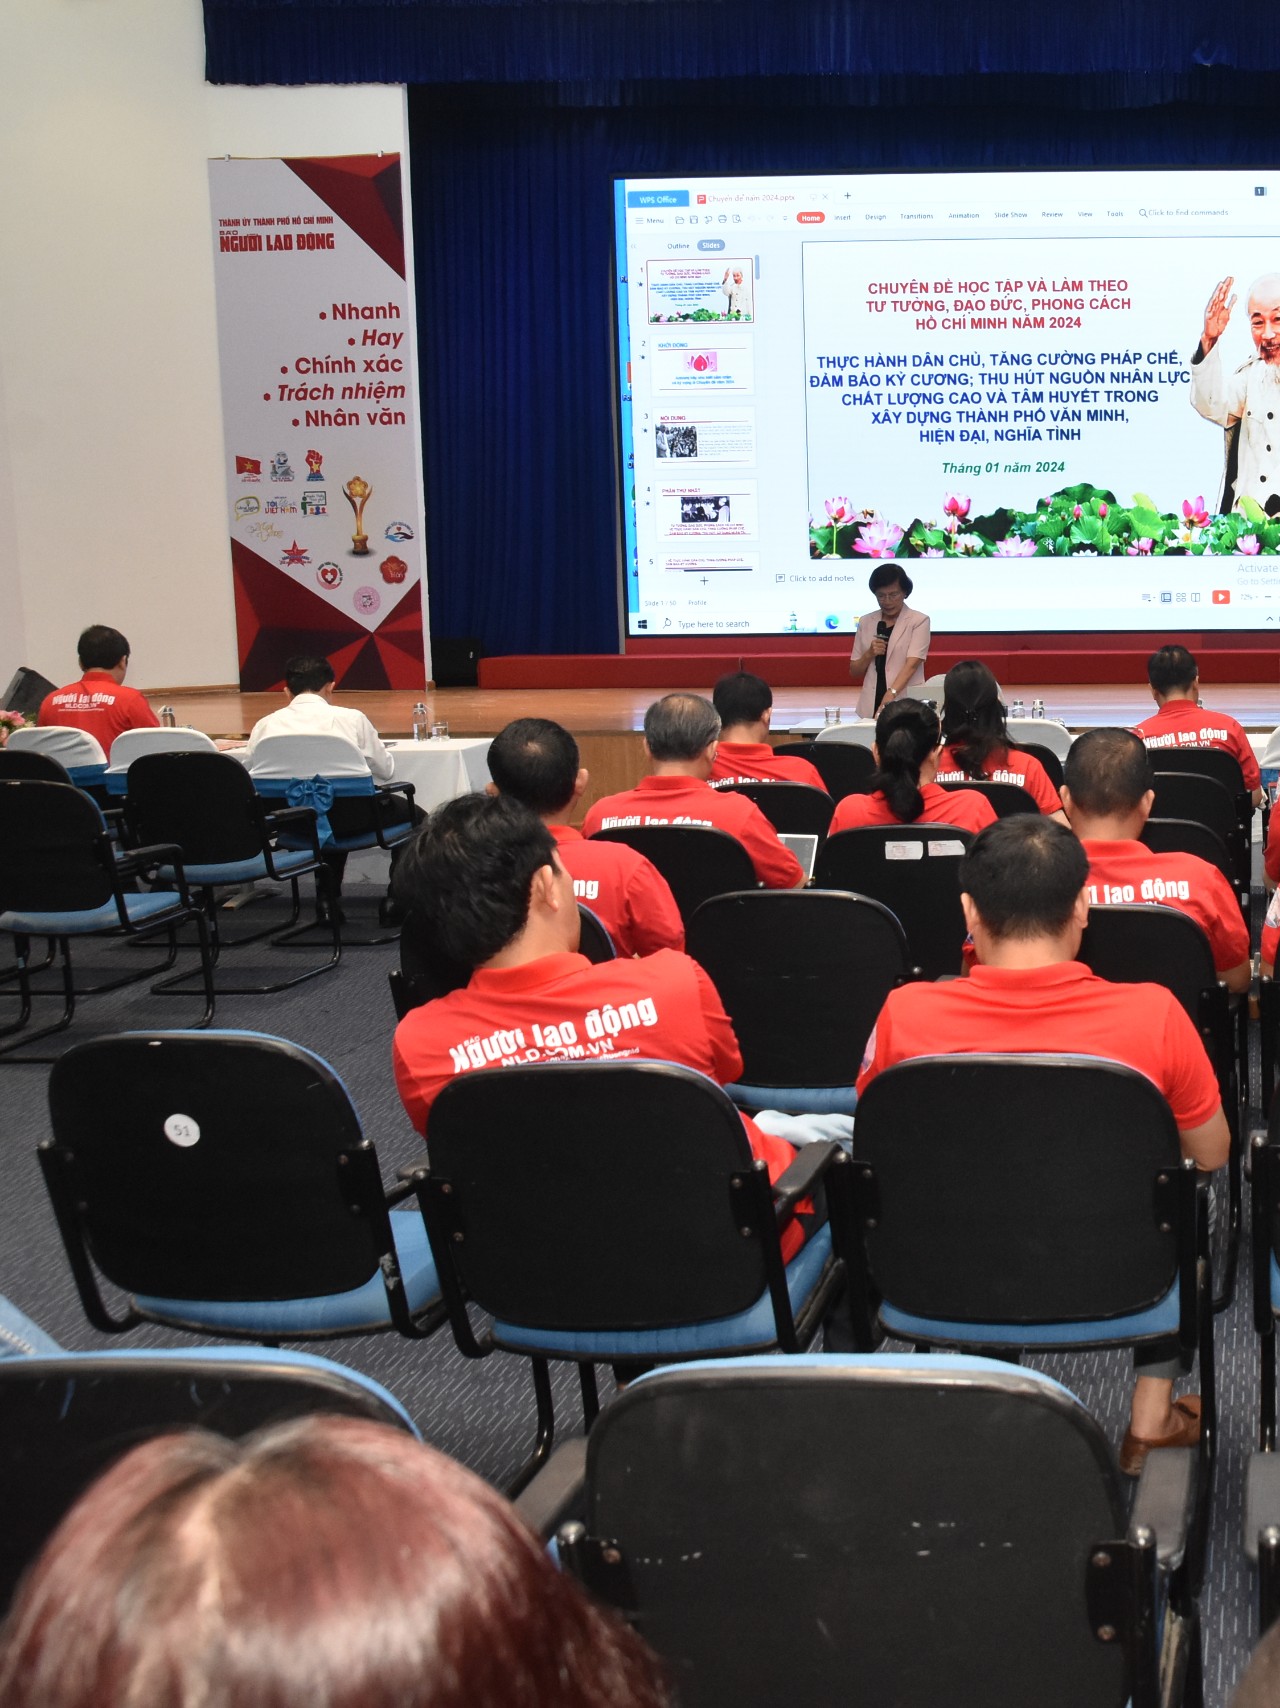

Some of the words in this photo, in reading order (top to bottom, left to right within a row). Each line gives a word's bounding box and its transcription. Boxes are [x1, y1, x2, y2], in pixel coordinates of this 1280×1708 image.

[1190, 208, 1228, 216] commands
[220, 234, 262, 252] NGƯỜI
[267, 234, 292, 251] LAO
[297, 232, 334, 251] ĐỘNG
[868, 279, 929, 294] CHUYÊN
[934, 278, 953, 294] ĐỀ
[958, 281, 989, 296] HỌC
[995, 279, 1023, 296] TẬP
[1027, 277, 1047, 292] VÀ
[1052, 277, 1083, 292] LÀM
[1088, 280, 1128, 291] THEO
[332, 303, 400, 320] Nhanh
[866, 301, 886, 312] TƯ
[891, 297, 949, 313] TƯỞNG,
[954, 300, 985, 314] ĐẠO
[991, 294, 1027, 312] ĐỨC,
[1032, 299, 1084, 310] PHONG
[1089, 295, 1131, 310] CÁCH
[916, 315, 937, 330] HỒ
[942, 314, 966, 329] CHÍ
[971, 318, 1007, 329] MINH
[1013, 314, 1044, 329] NĂM
[1049, 317, 1081, 328] 2024
[362, 329, 403, 349] Hay
[295, 355, 355, 374] Chính
[363, 354, 403, 372] xác
[817, 356, 859, 371] THỰC
[865, 352, 907, 367] HÀNH
[912, 352, 944, 367] DÂN
[949, 351, 985, 368] CHỦ,
[990, 351, 1032, 366] TĂNG
[1037, 350, 1095, 365] CƯỜNG
[1101, 349, 1142, 364] PHÁP
[1147, 349, 1183, 366] CHẾ,
[810, 373, 843, 387] ĐẢM
[849, 372, 880, 387] BẢO
[886, 371, 906, 386] KỶ
[911, 373, 973, 388] CƯƠNG;
[978, 373, 1009, 385] THU
[1015, 369, 1044, 384] HÚT
[1050, 369, 1105, 384] NGUỒN
[1110, 368, 1153, 383] NHÂN
[1159, 371, 1190, 386] LỰC
[278, 382, 334, 401] Trách
[341, 380, 405, 403] nhiệm
[842, 391, 883, 406] CHẤT
[888, 393, 944, 407] LƯỢNG
[949, 392, 982, 404] CAO
[986, 389, 1007, 404] VÀ
[1012, 388, 1043, 403] TÂM
[1049, 388, 1099, 403] HUYẾT
[1104, 390, 1159, 402] TRONG
[305, 408, 360, 426] Nhân
[367, 408, 406, 425] văn
[872, 409, 902, 424] XÂY
[907, 411, 951, 426] DỰNG
[957, 408, 1008, 423] THÀNH
[1014, 407, 1045, 422] PHỐ
[1050, 407, 1081, 421] VĂN
[1087, 410, 1129, 423] MINH,
[920, 428, 954, 445] HIỆN
[960, 429, 989, 444] ĐẠI,
[994, 426, 1042, 441] NGHĨA
[1046, 426, 1081, 440] TÌNH
[942, 462, 981, 476] Tháng
[985, 462, 999, 473] 01
[1004, 462, 1031, 473] năm
[1036, 462, 1065, 472] 2024
[1237, 563, 1278, 573] Activate
[678, 620, 695, 629] Type
[698, 620, 713, 628] here
[725, 620, 749, 628] search
[1178, 732, 1196, 742] lao
[1200, 728, 1227, 741] động
[1103, 885, 1134, 904] lao
[1141, 878, 1189, 901] động
[449, 1028, 527, 1074] Người
[532, 1021, 577, 1047] lao
[585, 997, 658, 1037] động
